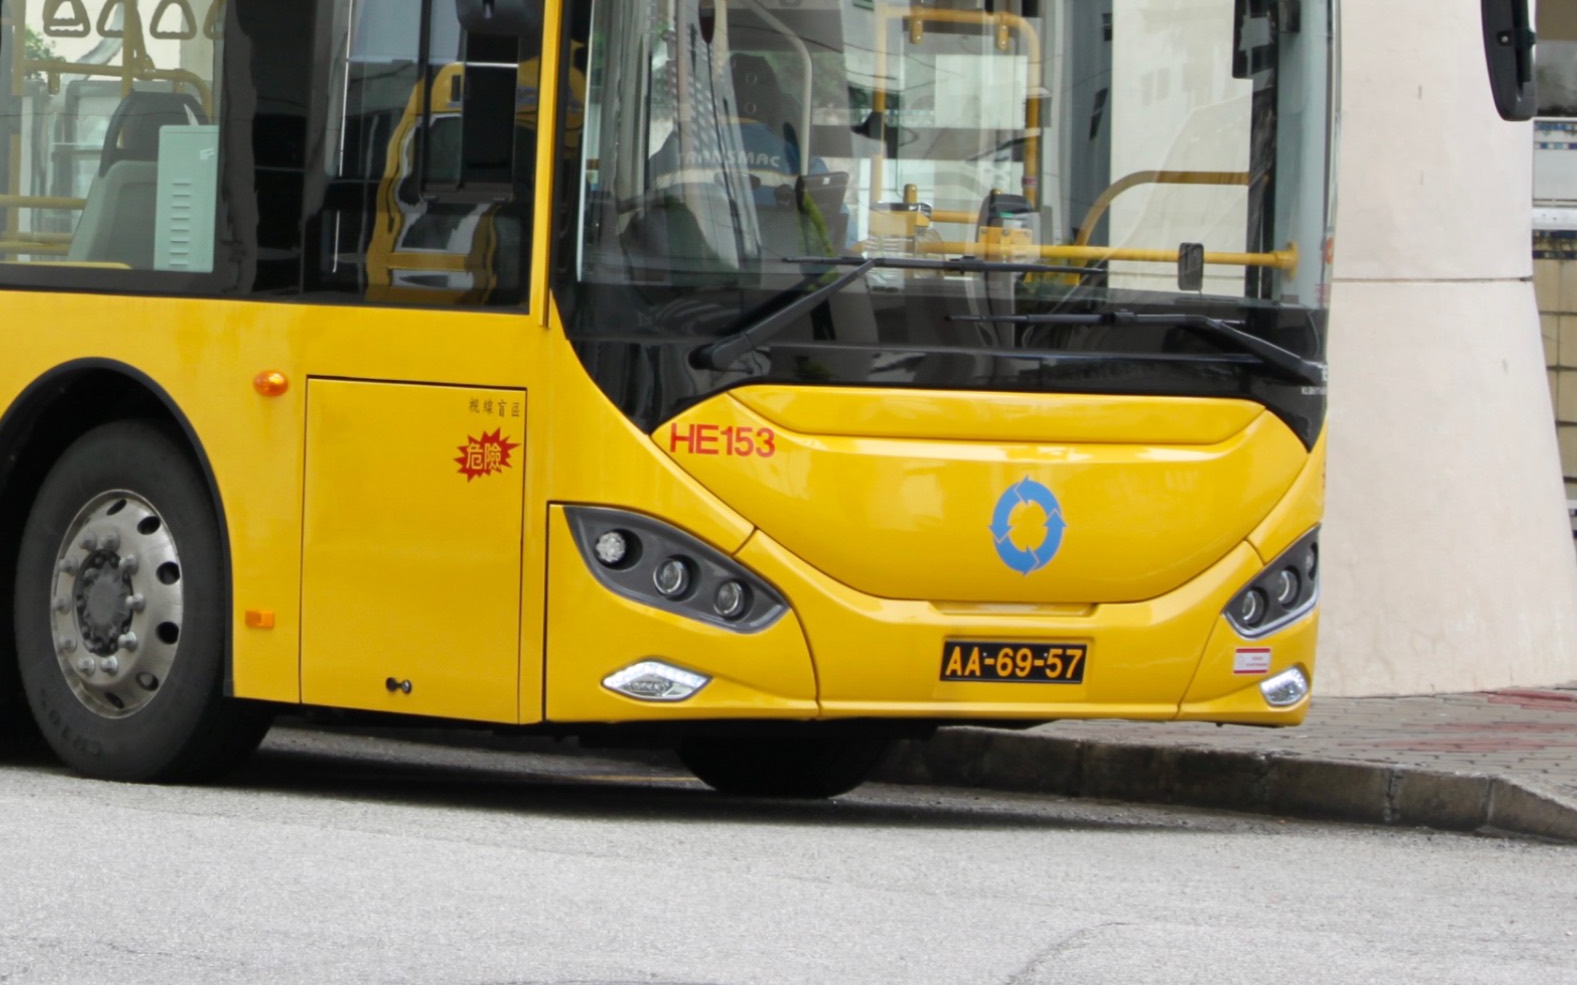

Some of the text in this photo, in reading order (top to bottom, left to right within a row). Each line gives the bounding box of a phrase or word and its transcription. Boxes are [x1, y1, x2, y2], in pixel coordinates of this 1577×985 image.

[466, 442, 502, 470] 危險
[669, 422, 776, 458] HE153
[944, 645, 1084, 680] AA-69-57
